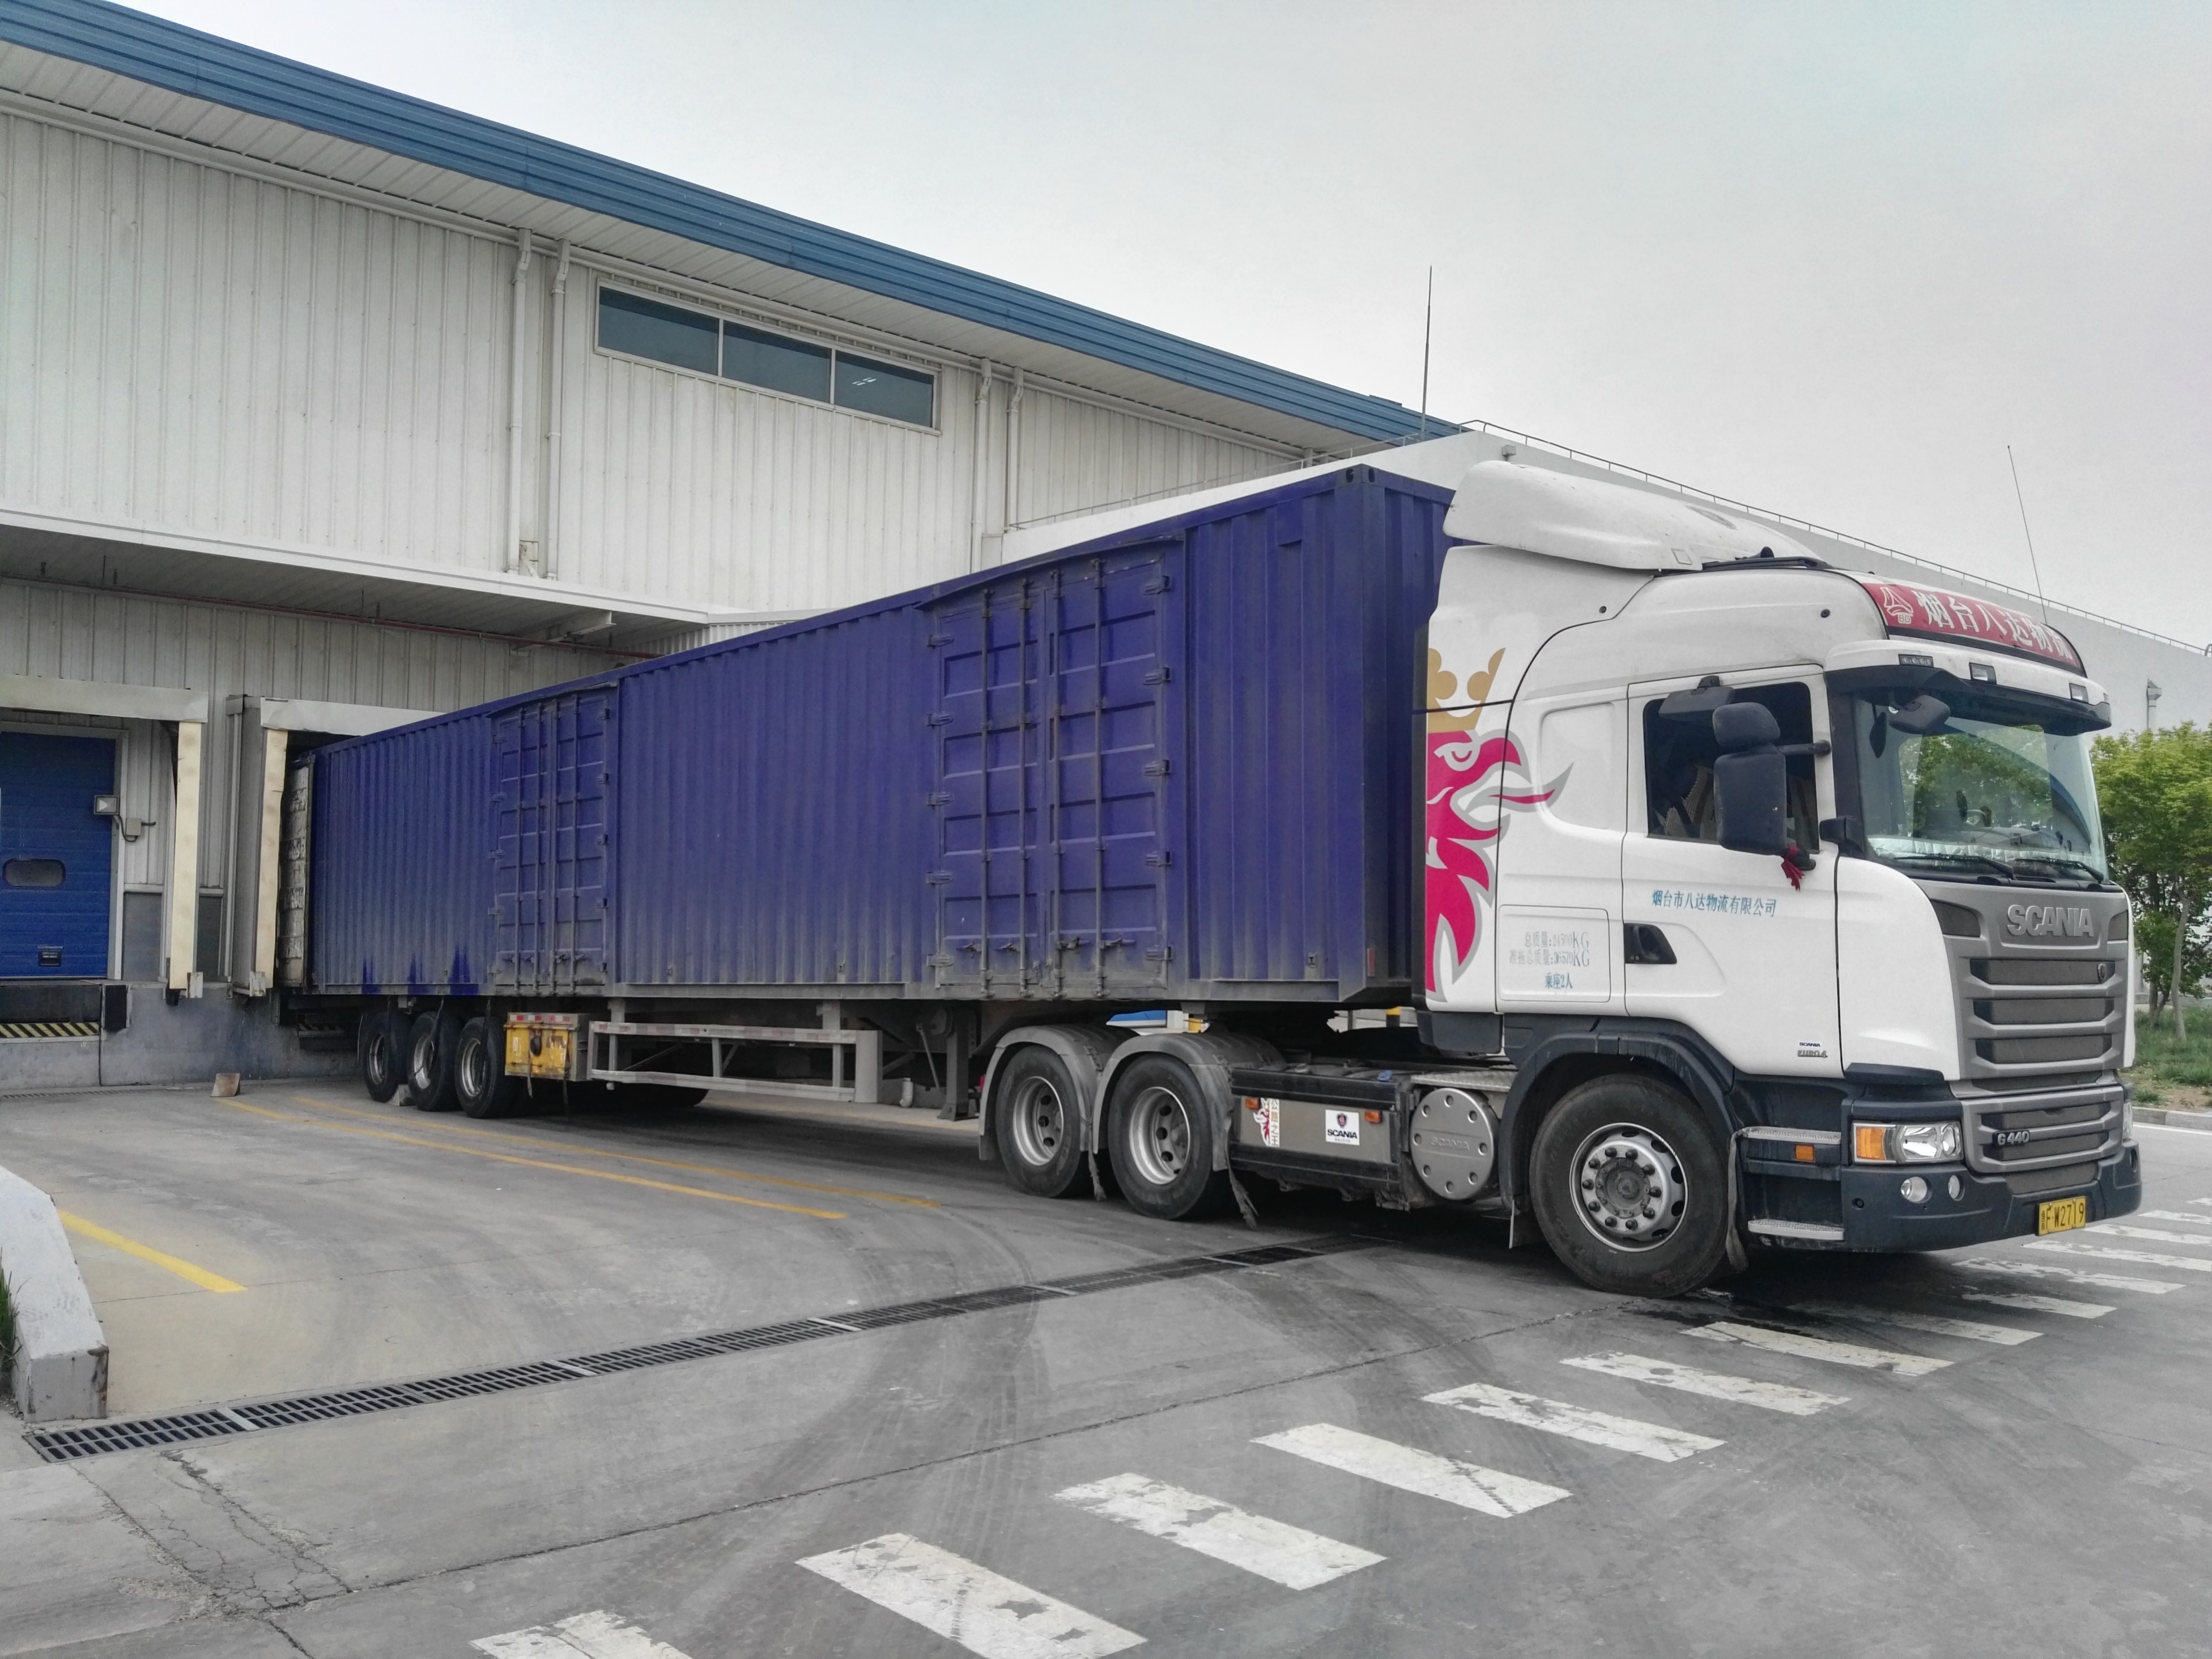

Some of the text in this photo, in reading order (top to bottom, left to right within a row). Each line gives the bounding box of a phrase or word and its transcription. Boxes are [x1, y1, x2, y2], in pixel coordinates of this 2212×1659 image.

[1899, 614, 1910, 623] BD
[1652, 890, 1777, 917] 烟台市八达物流有限公司
[2007, 904, 2094, 937] SCANIA
[1327, 1128, 1358, 1139] SCANIA
[1430, 1137, 1470, 1151] SCANIA
